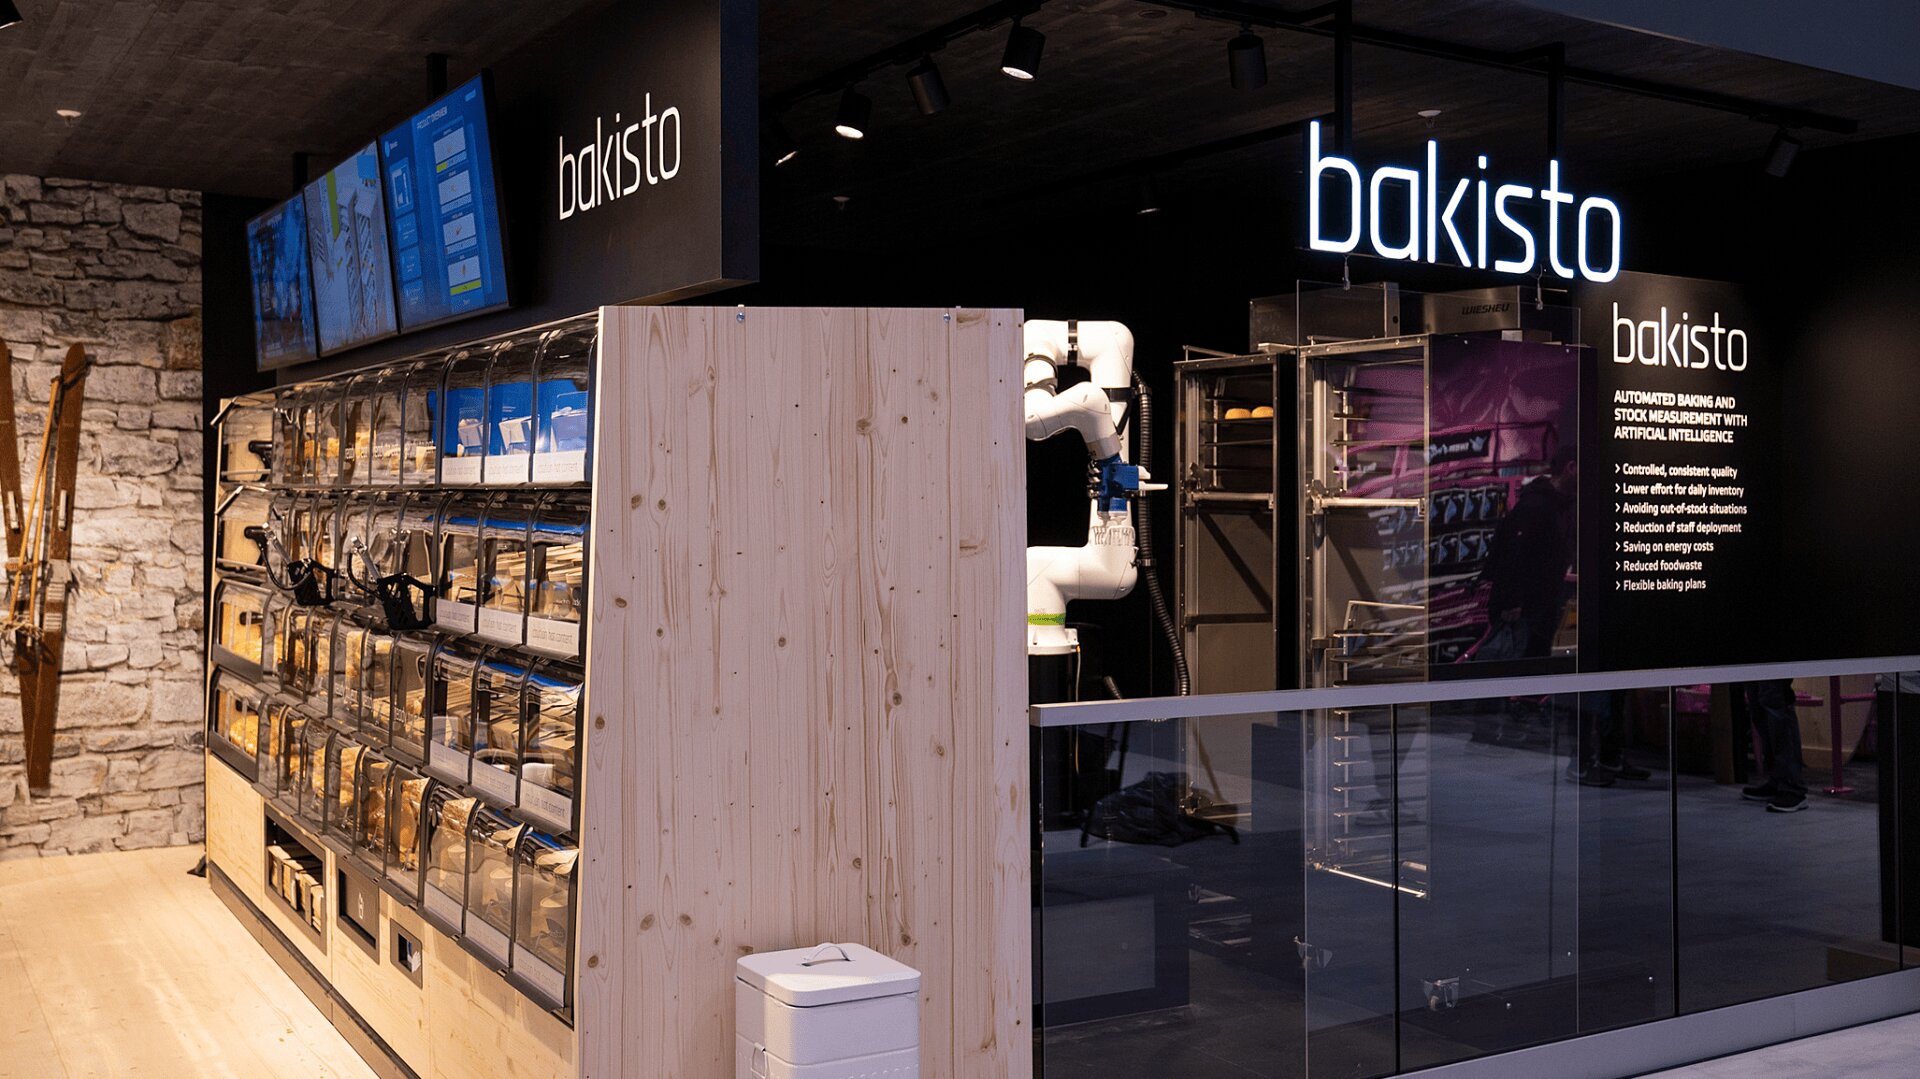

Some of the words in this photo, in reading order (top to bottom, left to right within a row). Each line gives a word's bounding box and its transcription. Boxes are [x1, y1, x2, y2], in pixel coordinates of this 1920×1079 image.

[559, 92, 681, 220] bakisto
[1309, 120, 1620, 283] bakisto
[1461, 303, 1511, 315] WIESHEU
[1613, 302, 1747, 371] bakisto
[1614, 390, 1675, 406] AUTOMATED
[1678, 394, 1713, 408] BAKING
[1714, 396, 1735, 409] AND
[1614, 408, 1647, 422] STOCK
[1649, 411, 1722, 425] MEASUREMENT
[1723, 414, 1747, 426] WITH
[1614, 426, 1667, 440] ARTIFICIAL
[1669, 428, 1734, 443] INTELLIGENCE
[1623, 463, 1667, 477] Controlled,
[1669, 465, 1709, 477] consistent
[1711, 466, 1737, 479] quality
[1623, 483, 1649, 494] Lower
[1650, 483, 1673, 495] effort
[1675, 484, 1687, 495] for
[1688, 484, 1707, 497] daily
[1708, 485, 1744, 498] inventory
[1623, 502, 1658, 516] Avoiding
[1660, 503, 1708, 514] out-of-stock
[1709, 504, 1747, 514] situations
[1623, 522, 1664, 533] Reduction
[1666, 522, 1675, 532] of
[1677, 522, 1695, 532] staff
[1697, 523, 1741, 535] deployment
[1623, 541, 1650, 554] Saving
[1653, 543, 1663, 551] on
[1665, 542, 1692, 554] energy
[1693, 542, 1714, 551] costs
[1624, 561, 1658, 571] Reduced
[1660, 560, 1702, 571] foodwaste
[1624, 580, 1655, 591] Flexible
[1657, 579, 1683, 592] baking
[1685, 578, 1706, 591] plans
